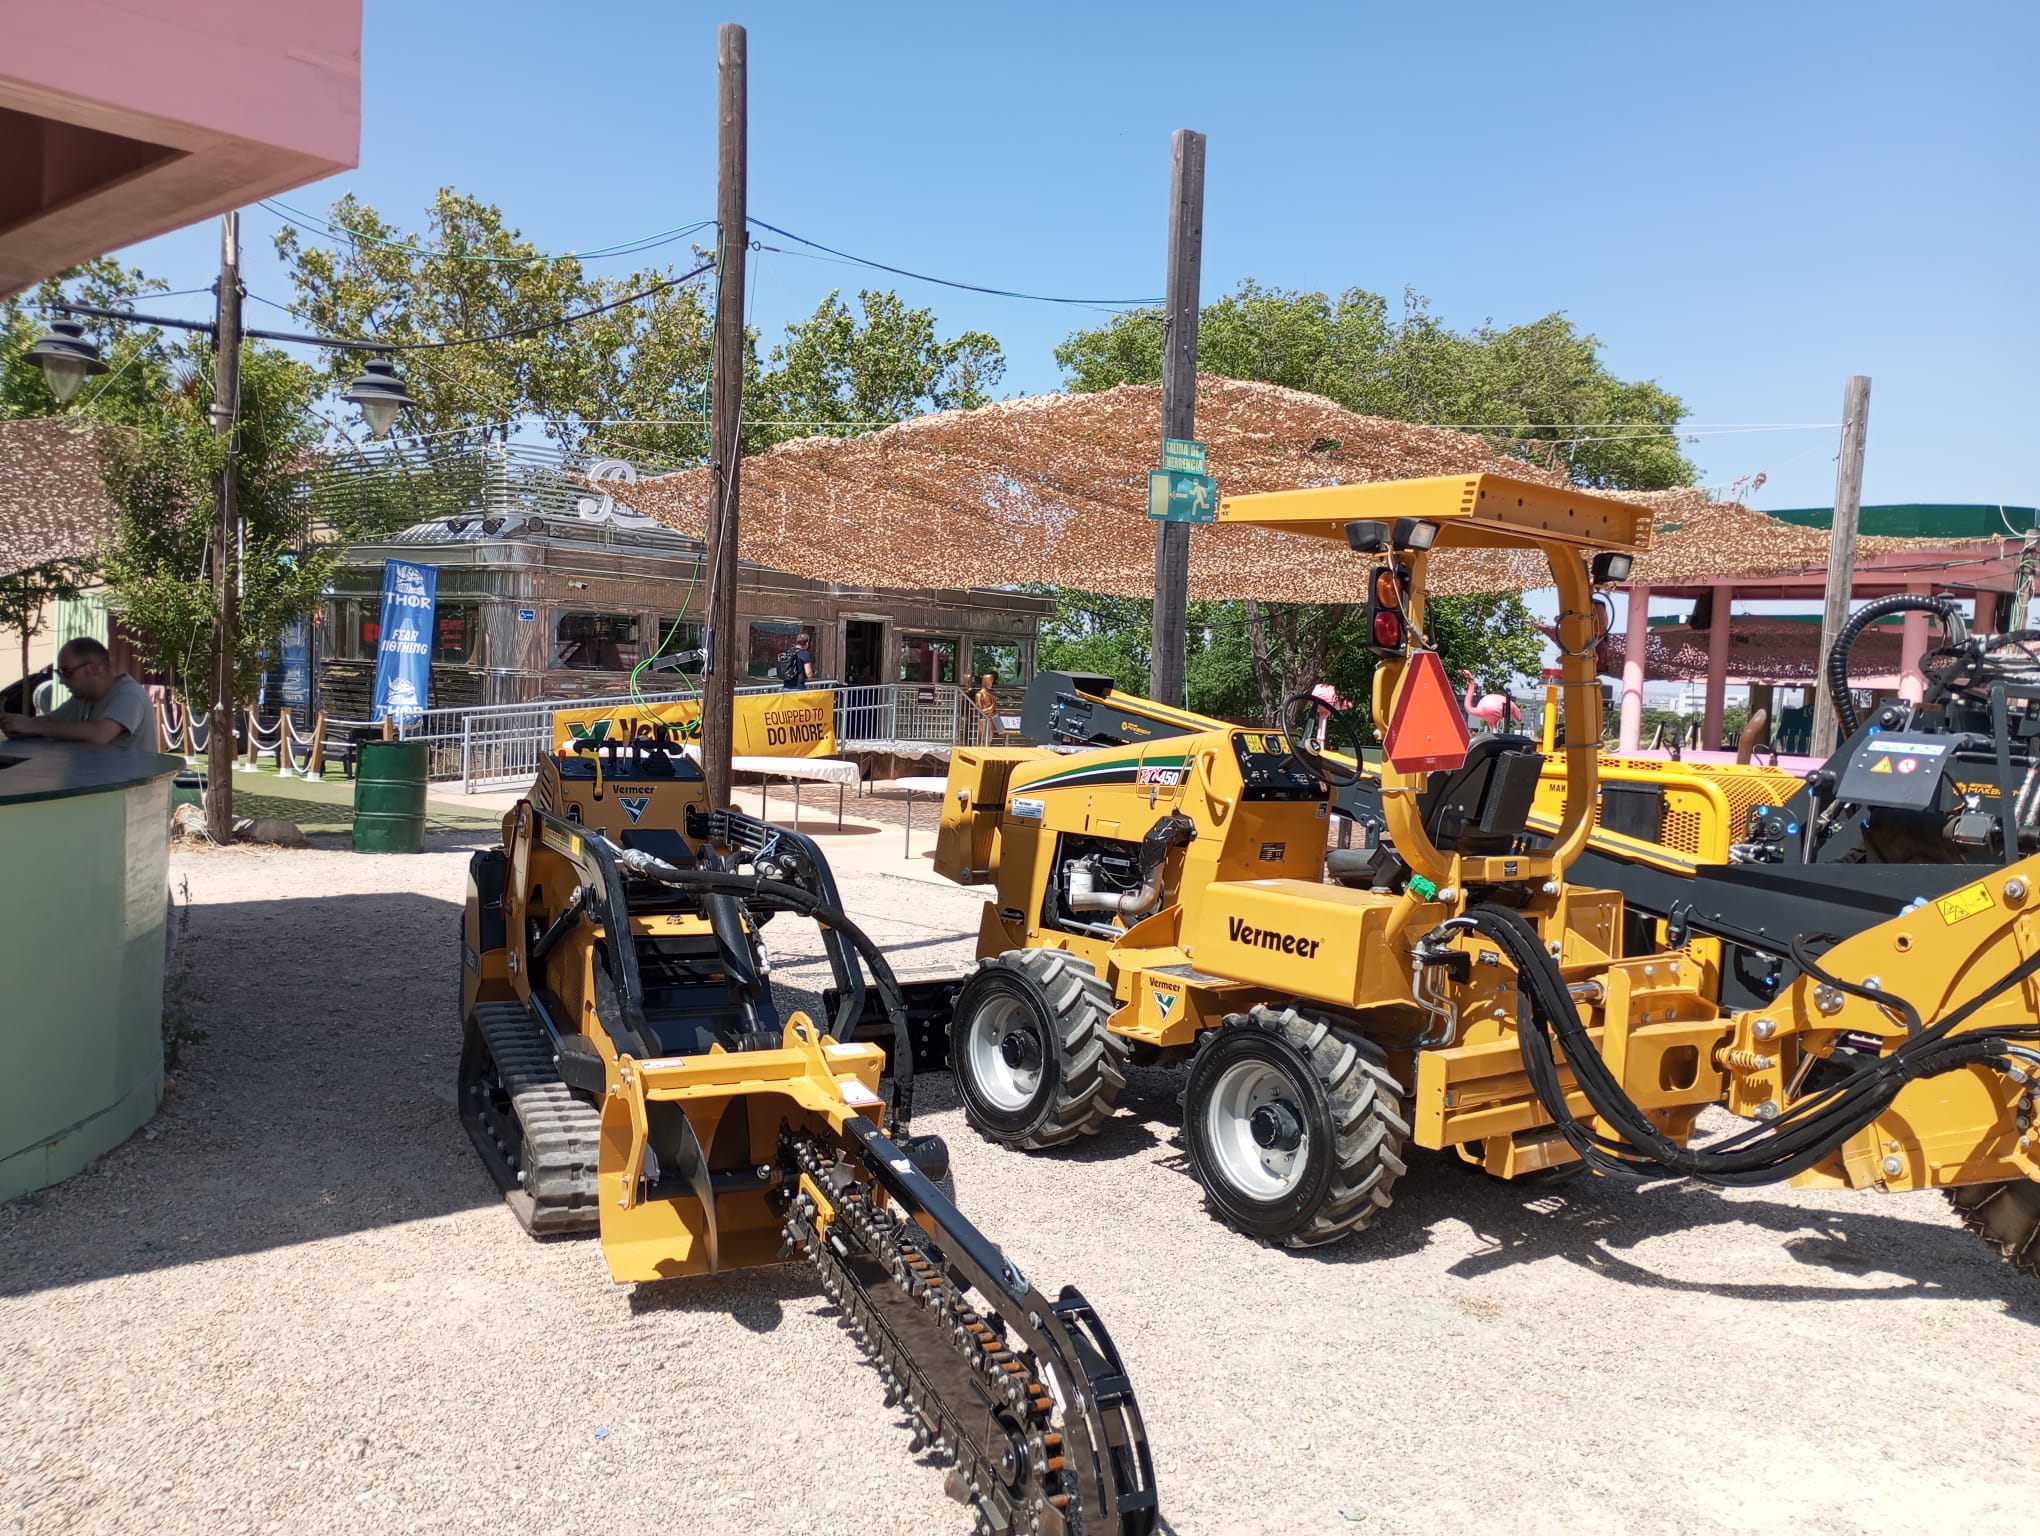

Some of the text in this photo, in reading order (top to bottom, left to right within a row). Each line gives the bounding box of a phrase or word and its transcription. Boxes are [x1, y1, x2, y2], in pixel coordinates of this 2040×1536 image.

[1166, 441, 1188, 456] SALIDA
[1164, 455, 1203, 472] EMERGENCIA
[385, 592, 431, 610] THOR
[392, 629, 418, 642] FEAR
[381, 640, 428, 655] NOTHING
[764, 708, 824, 726] EQUIPPED TO
[767, 726, 787, 746] DO
[612, 784, 655, 795] Vermeer
[1229, 916, 1321, 959] Vermeer
[1149, 976, 1182, 993] Vermeer
